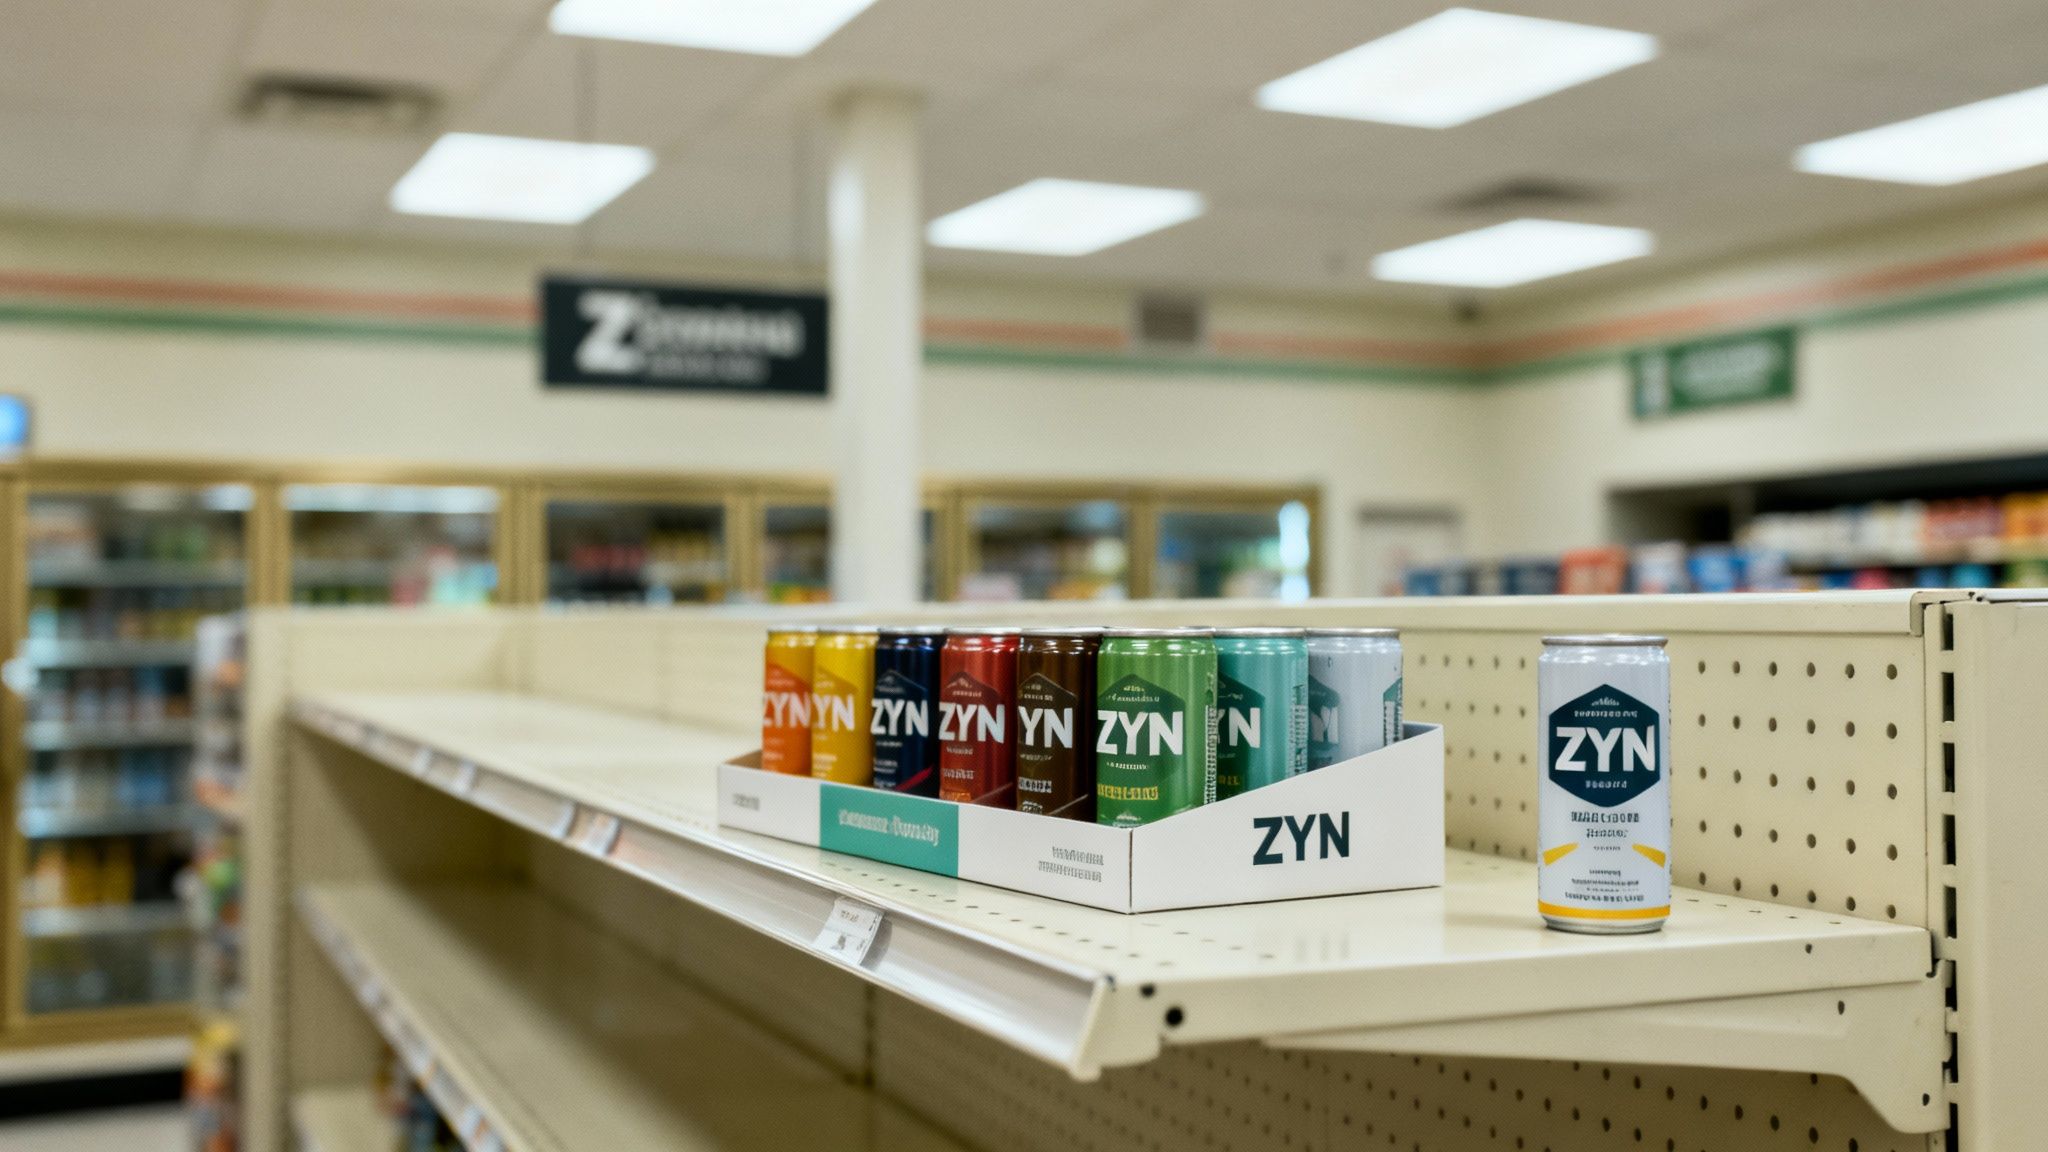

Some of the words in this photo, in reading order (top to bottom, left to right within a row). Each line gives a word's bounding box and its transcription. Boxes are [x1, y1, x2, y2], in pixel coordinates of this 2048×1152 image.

[812, 693, 855, 732] YN
[870, 698, 929, 737] ZYN
[938, 701, 1006, 744] ZYN
[1018, 706, 1073, 748] YN
[1096, 709, 1183, 756] ZYN
[1555, 725, 1656, 773] ZYN
[1252, 811, 1350, 865] ZYN
